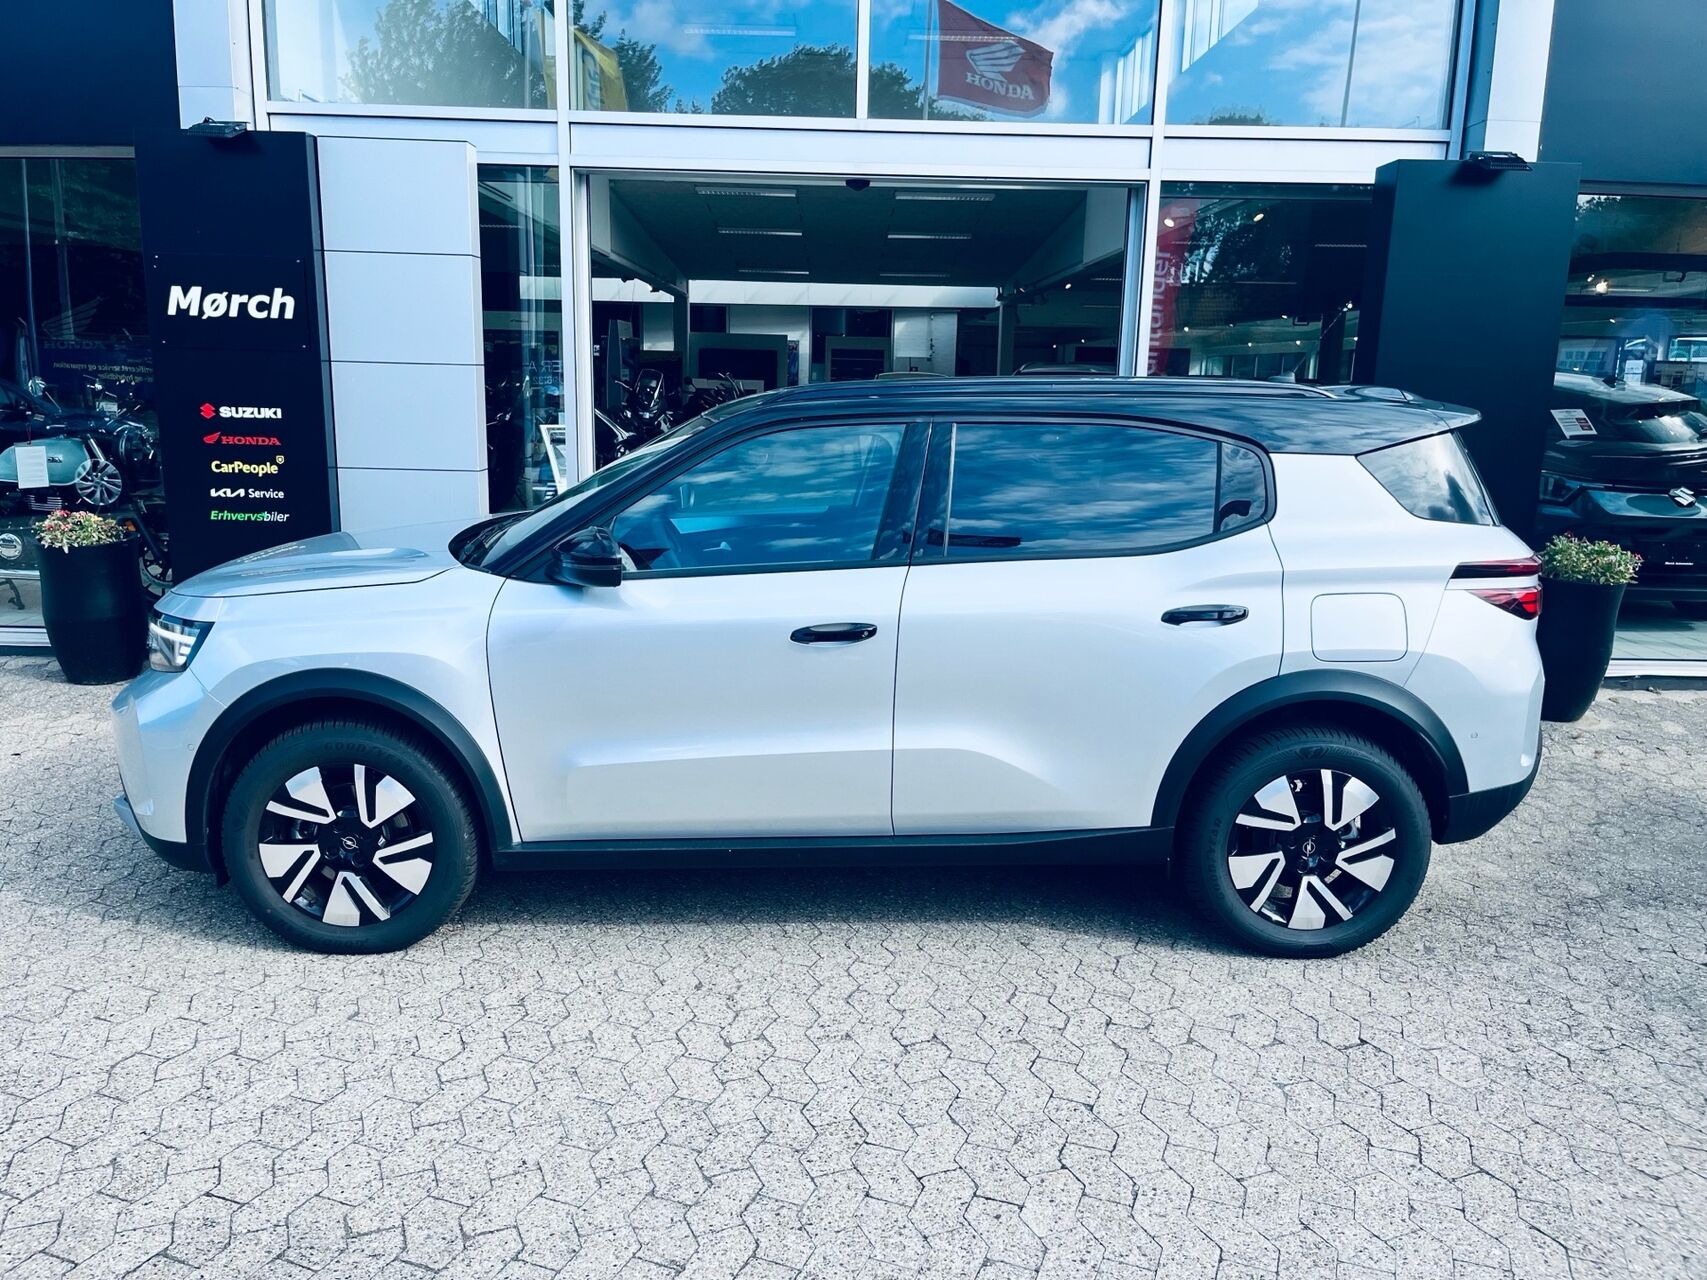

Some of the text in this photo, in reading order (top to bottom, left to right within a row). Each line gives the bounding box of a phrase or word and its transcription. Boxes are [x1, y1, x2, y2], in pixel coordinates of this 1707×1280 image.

[966, 72, 1034, 100] HONDA
[167, 285, 295, 320] Mørch
[219, 406, 282, 419] SUZUKI
[221, 436, 282, 446] HONDA
[211, 460, 279, 477] CarPeople
[248, 488, 285, 499] Service
[210, 510, 290, 522] Erhvervsbiler
